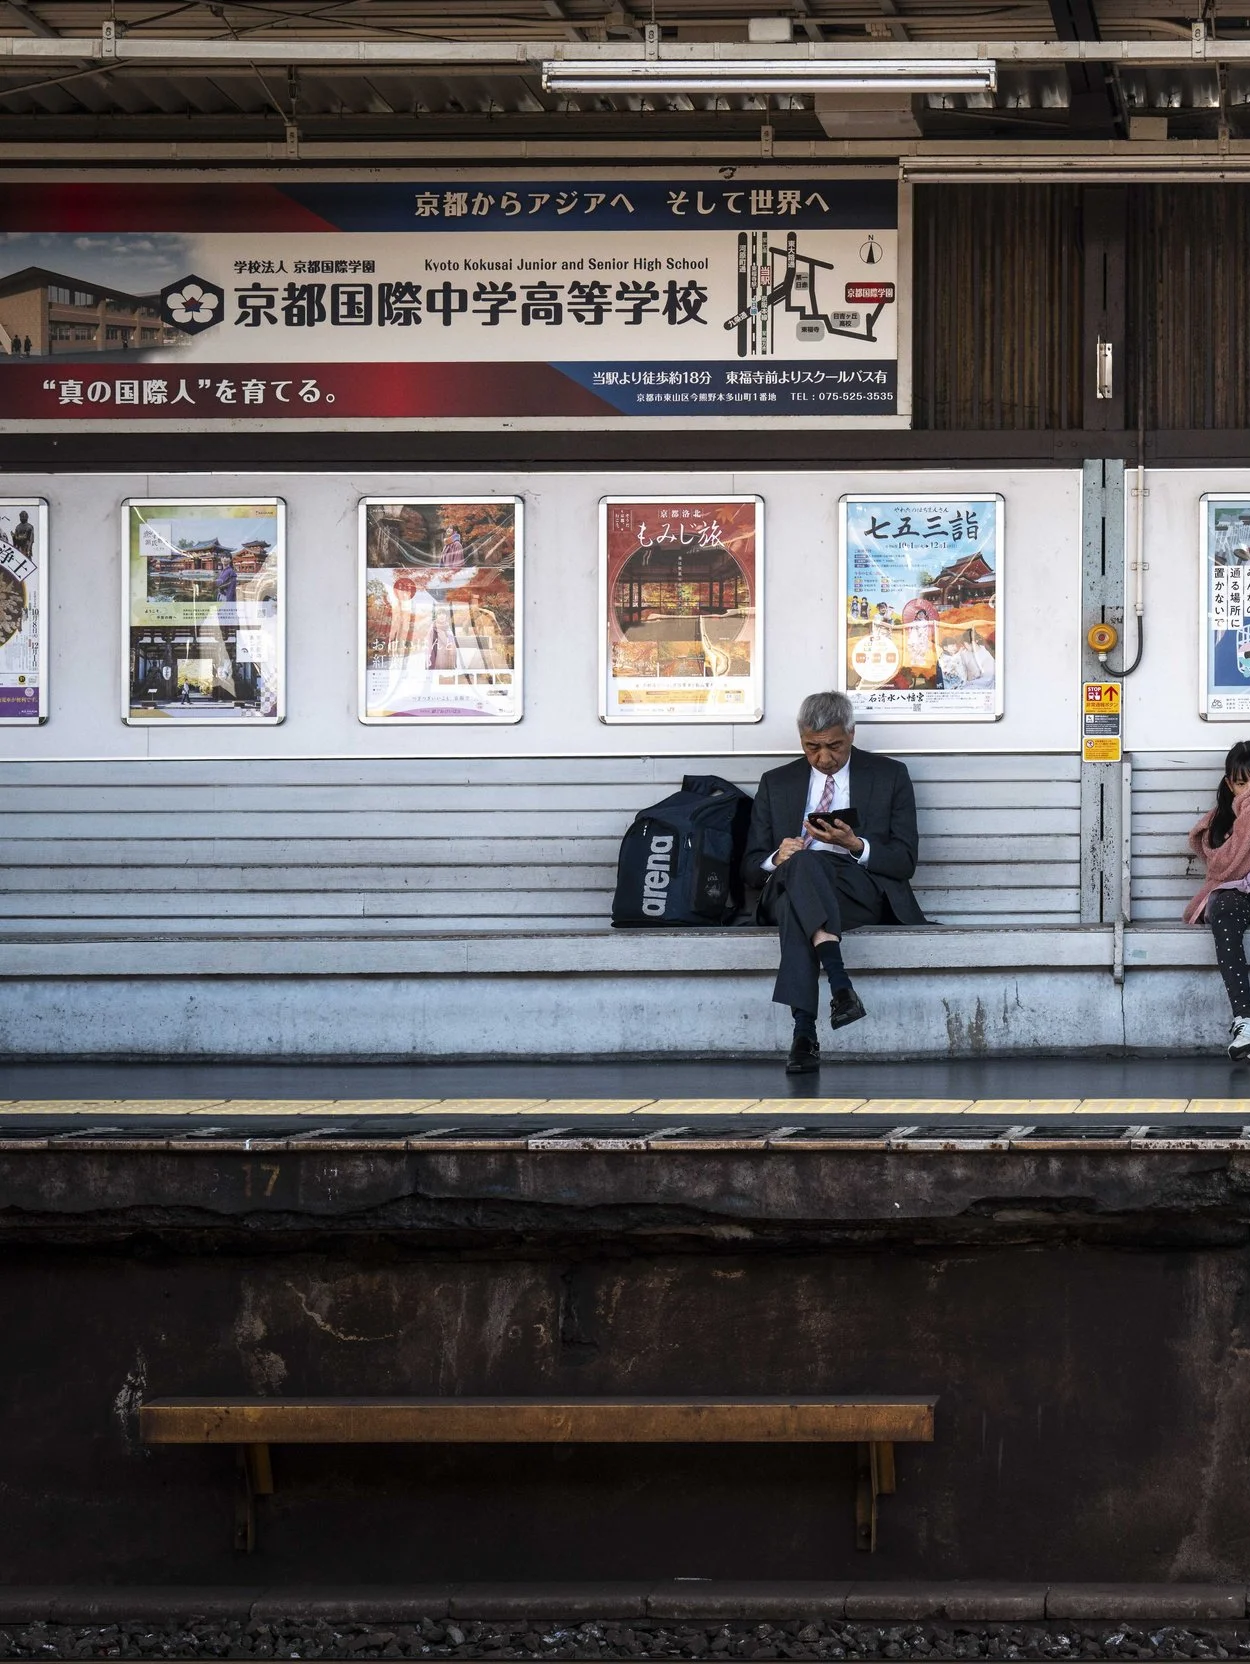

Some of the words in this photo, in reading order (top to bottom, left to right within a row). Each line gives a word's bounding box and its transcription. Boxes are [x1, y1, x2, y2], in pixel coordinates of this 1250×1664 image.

[414, 190, 636, 217] 京都からアジアへ
[666, 190, 830, 217] そして世界へ
[233, 260, 289, 274] 学校法人
[293, 260, 376, 274] 京都国際学園
[424, 257, 460, 273] Kyoto
[463, 257, 513, 270] Kokusai
[517, 257, 556, 271] Junior
[558, 257, 584, 270] and
[587, 257, 629, 270] Senior
[632, 257, 664, 273] High
[666, 256, 709, 270] School
[234, 280, 708, 328] 京都国際中学高等学校
[592, 371, 712, 386] 当駅より徒歩約18分
[725, 370, 888, 385] 東福寺前よりスクールバス有
[818, 391, 894, 401] 075-525-3535
[637, 521, 725, 548] もみじ旅
[864, 510, 980, 541] 七五三詣
[1214, 567, 1225, 627] 置かないで
[1229, 567, 1241, 628] 通る場所に
[868, 693, 925, 703] 石清水八幡宮
[642, 835, 674, 917] arena
